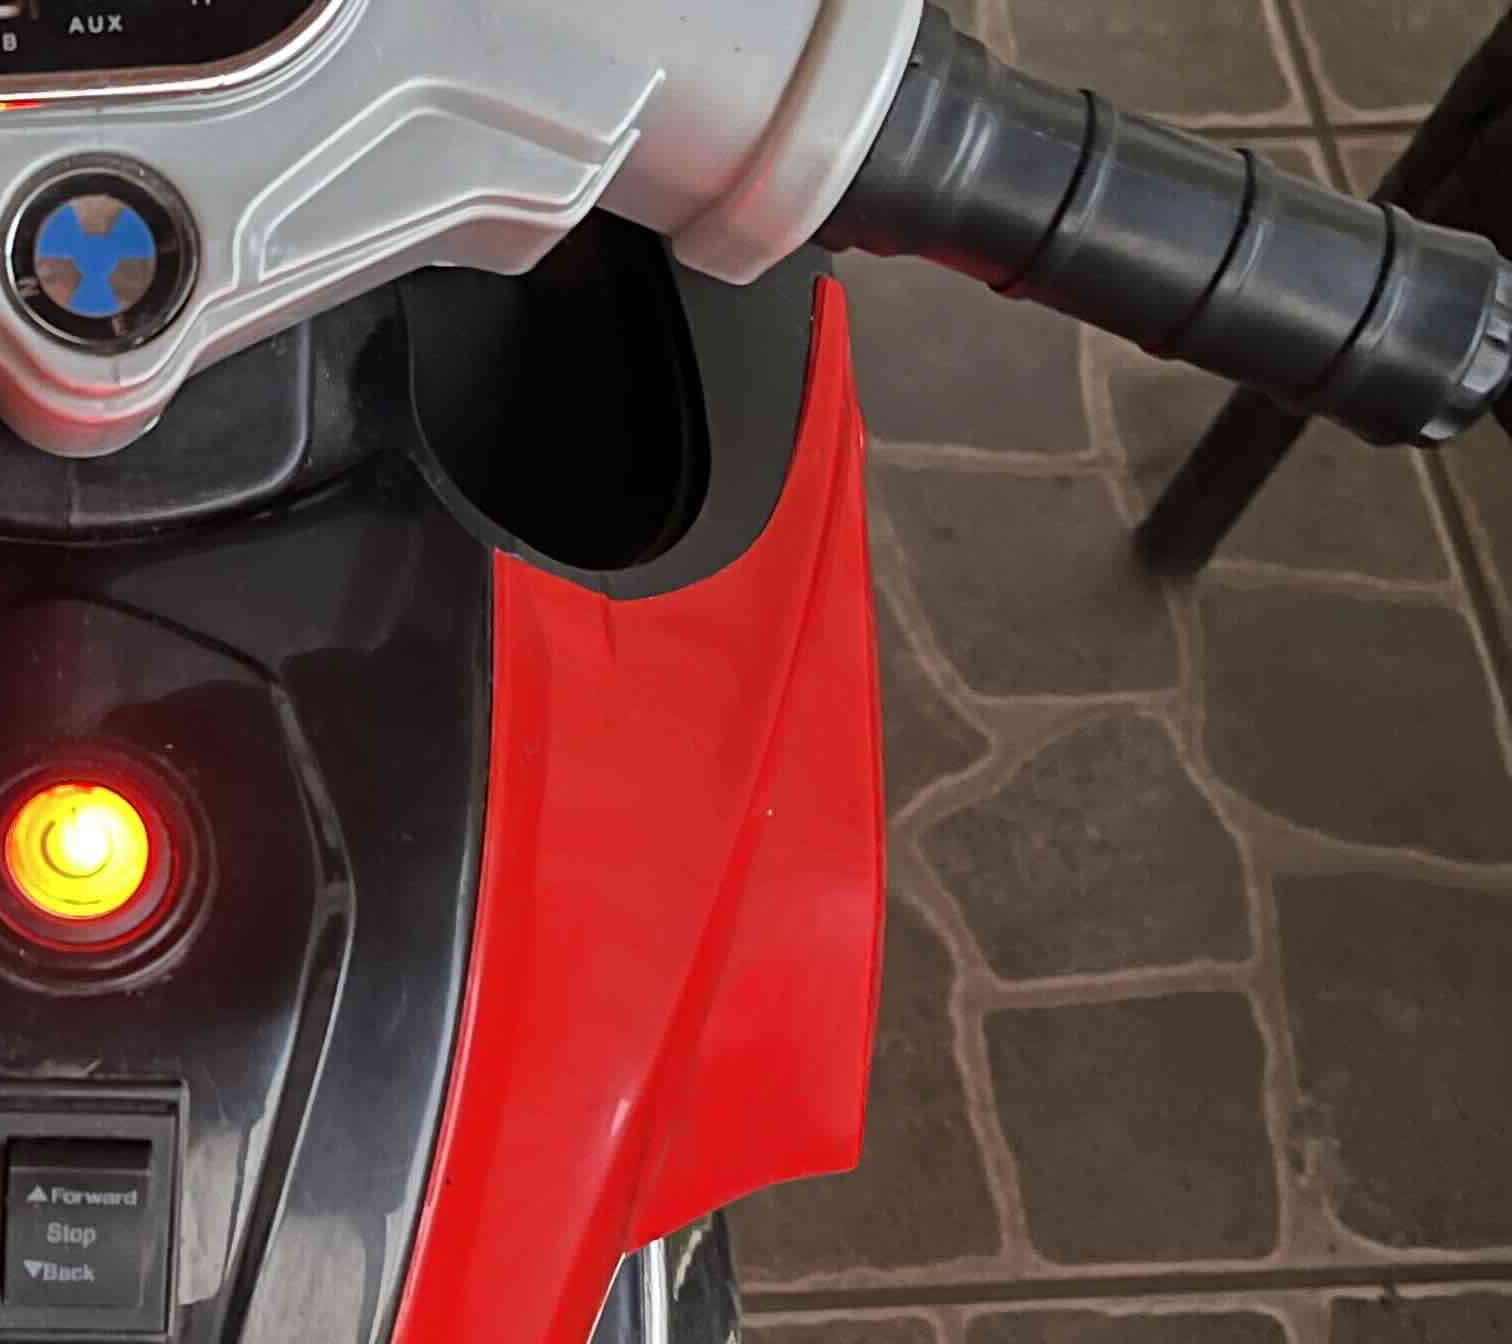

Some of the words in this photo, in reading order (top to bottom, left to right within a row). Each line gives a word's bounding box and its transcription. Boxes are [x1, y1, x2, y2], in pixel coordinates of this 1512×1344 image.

[69, 14, 123, 34] AUX
[50, 1186, 137, 1207] Forward
[46, 1222, 96, 1248] Stop
[42, 1262, 95, 1283] Back
